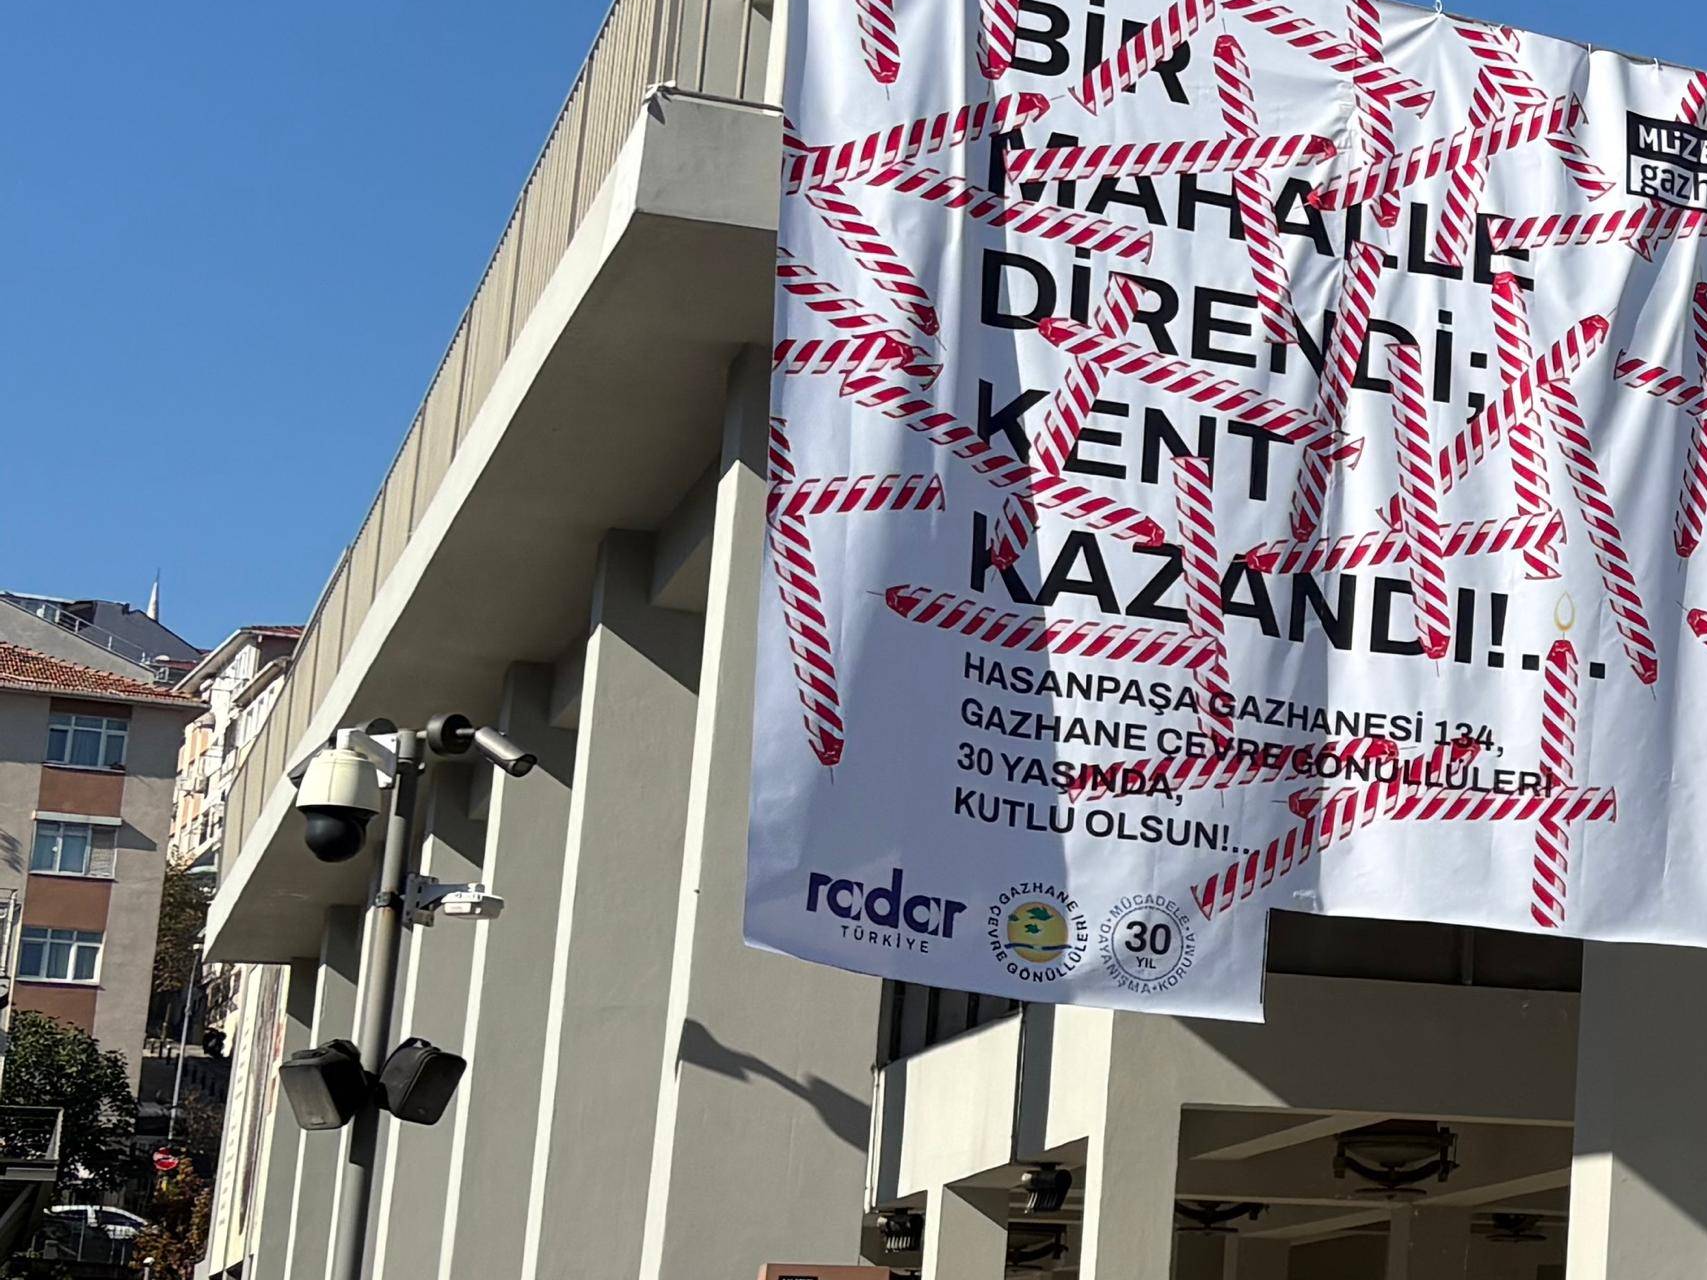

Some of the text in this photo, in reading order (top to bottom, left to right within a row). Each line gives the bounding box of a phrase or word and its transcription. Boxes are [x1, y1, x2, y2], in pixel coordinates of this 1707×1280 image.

[988, 128, 1535, 292] MAHALLE
[975, 378, 1296, 502] KENT
[960, 697, 1148, 752] GAZHANE
[1156, 728, 1284, 771] ÇEVRE
[964, 651, 1504, 758] HASANPAŞA GAZHANESİ 134,
[956, 742, 1184, 807] 30 YAŞINDA,
[954, 786, 1075, 834] KUTLU
[805, 867, 968, 939] radar
[998, 882, 1079, 913] GAZHANE
[841, 924, 930, 955] TÜRKİYE
[1124, 920, 1172, 956] 30
[1135, 956, 1157, 970] YIL
